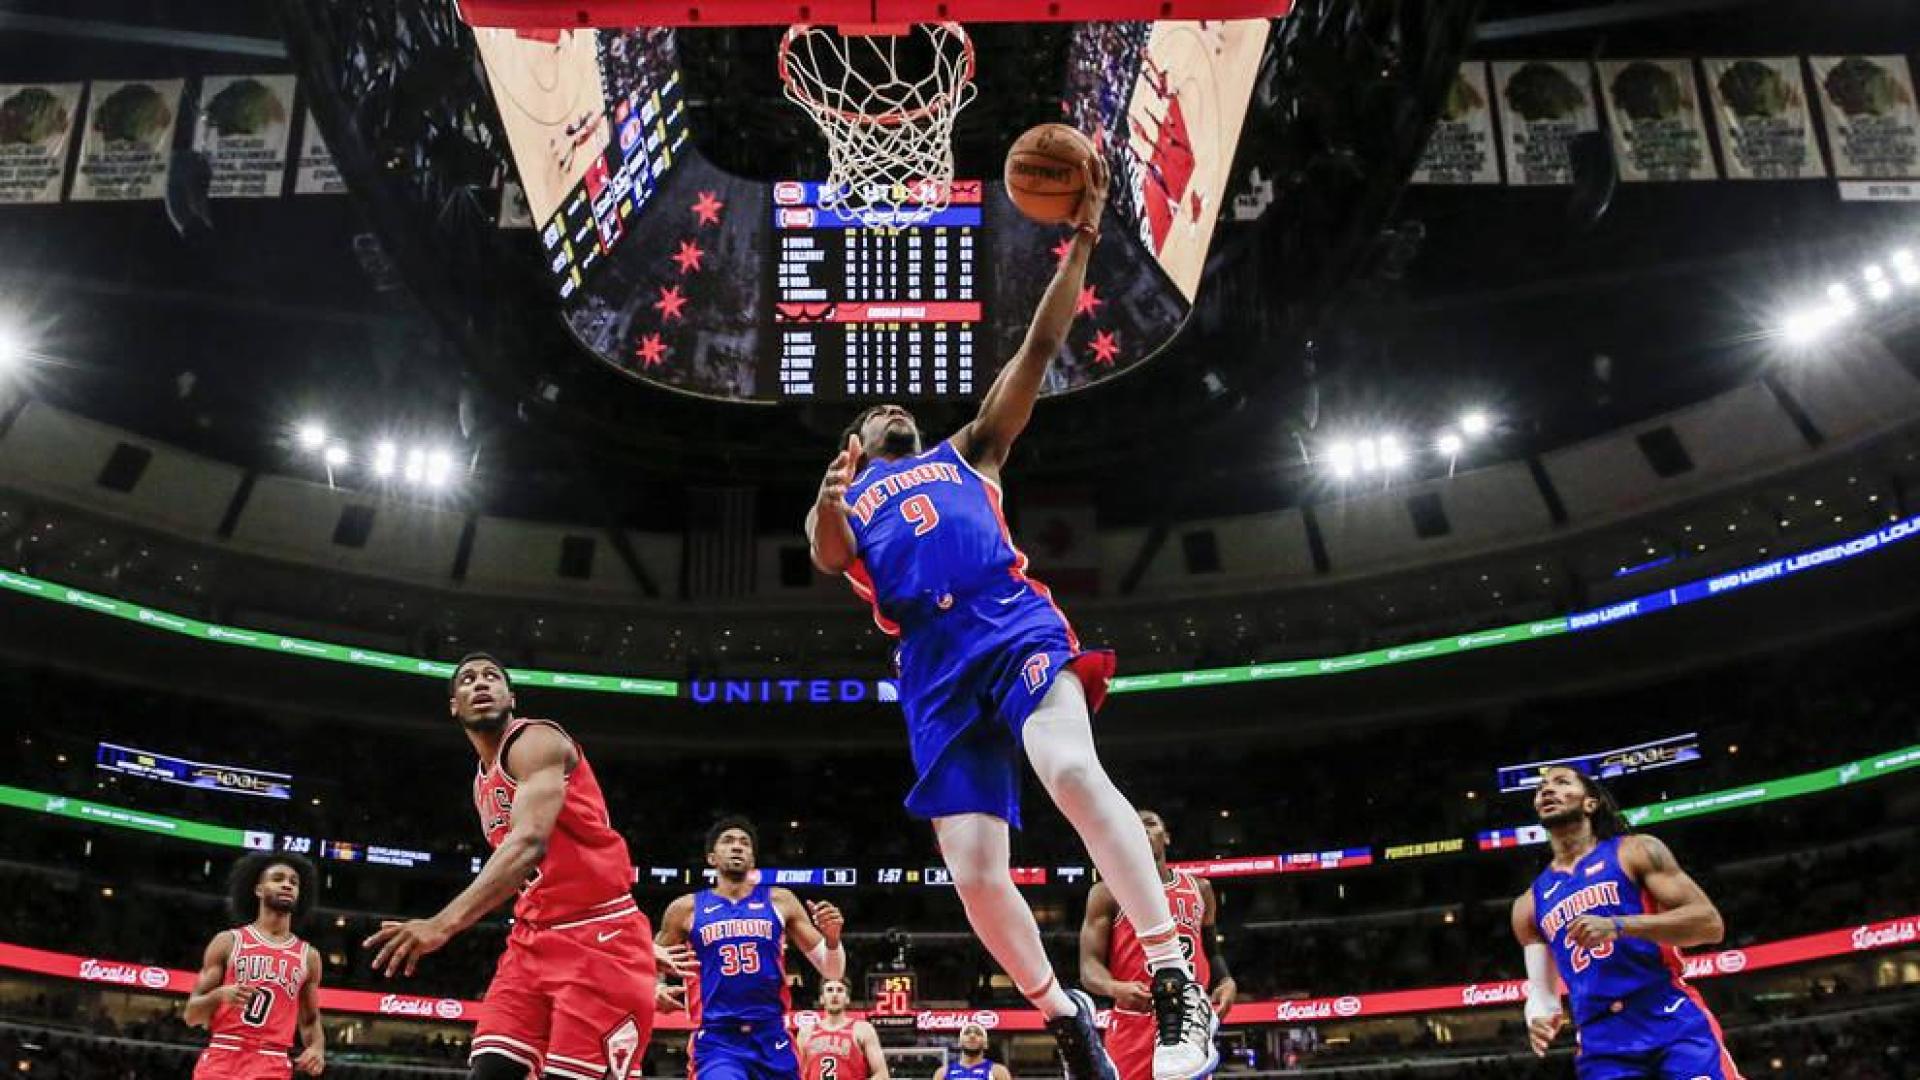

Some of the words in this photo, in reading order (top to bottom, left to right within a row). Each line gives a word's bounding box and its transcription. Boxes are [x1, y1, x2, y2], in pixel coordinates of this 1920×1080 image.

[853, 462, 962, 526] DETROIT
[900, 494, 939, 536] 9
[1786, 534, 1879, 572] LEGENDS
[691, 681, 866, 703] UNITED
[1541, 881, 1620, 942] DETROIT
[699, 918, 773, 947] DETROIT
[234, 955, 301, 999] BULLS
[719, 941, 760, 976] 35
[241, 986, 276, 1028] 0
[876, 992, 907, 1015] 20
[820, 1056, 836, 1080] 2
